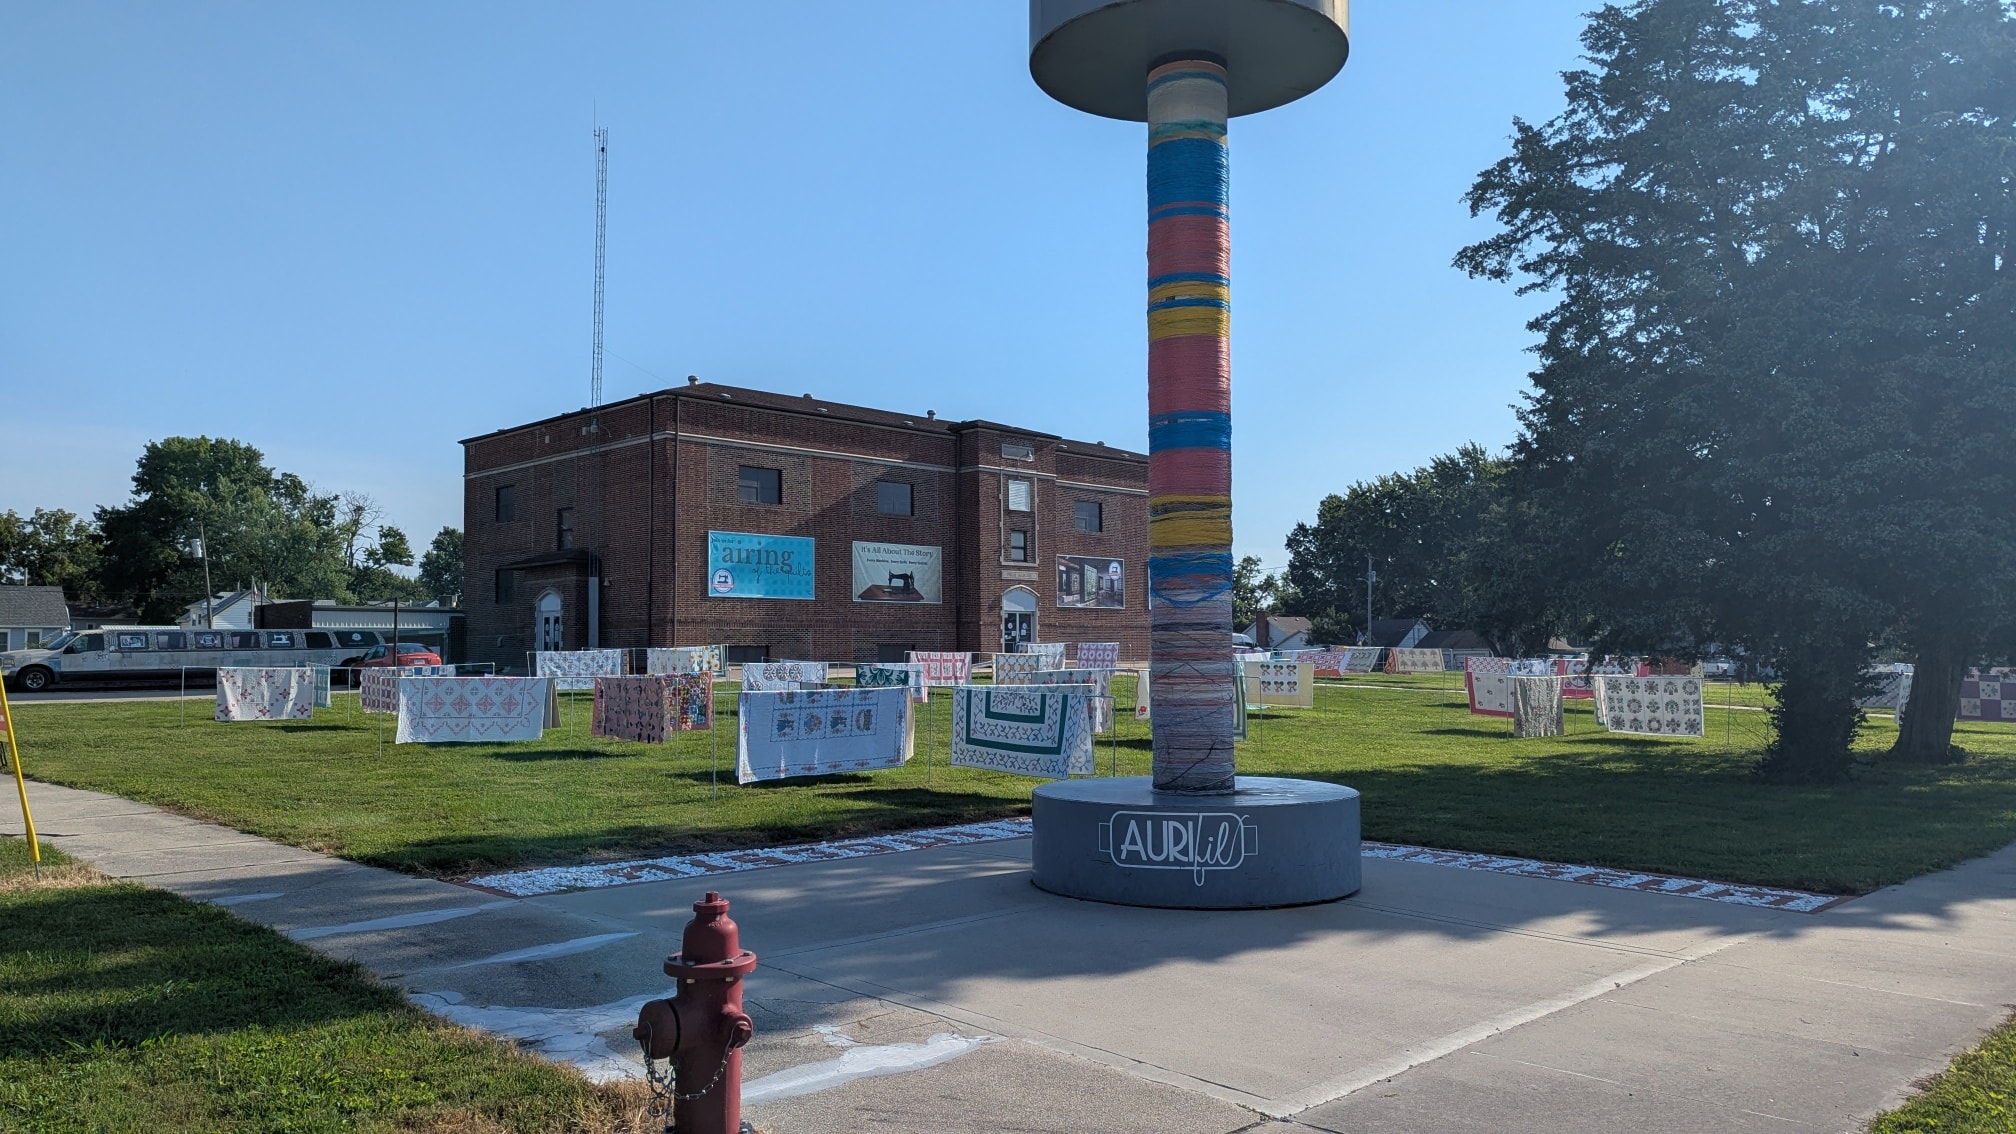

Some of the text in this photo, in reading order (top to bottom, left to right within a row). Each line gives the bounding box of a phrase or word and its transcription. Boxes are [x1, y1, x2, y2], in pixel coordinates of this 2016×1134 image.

[721, 540, 795, 574] airing
[871, 546, 882, 554] All
[882, 547, 902, 556] About
[902, 548, 915, 556] The
[915, 549, 934, 559] Story
[752, 562, 812, 585] of the quilts
[1120, 815, 1249, 886] AURIfil
